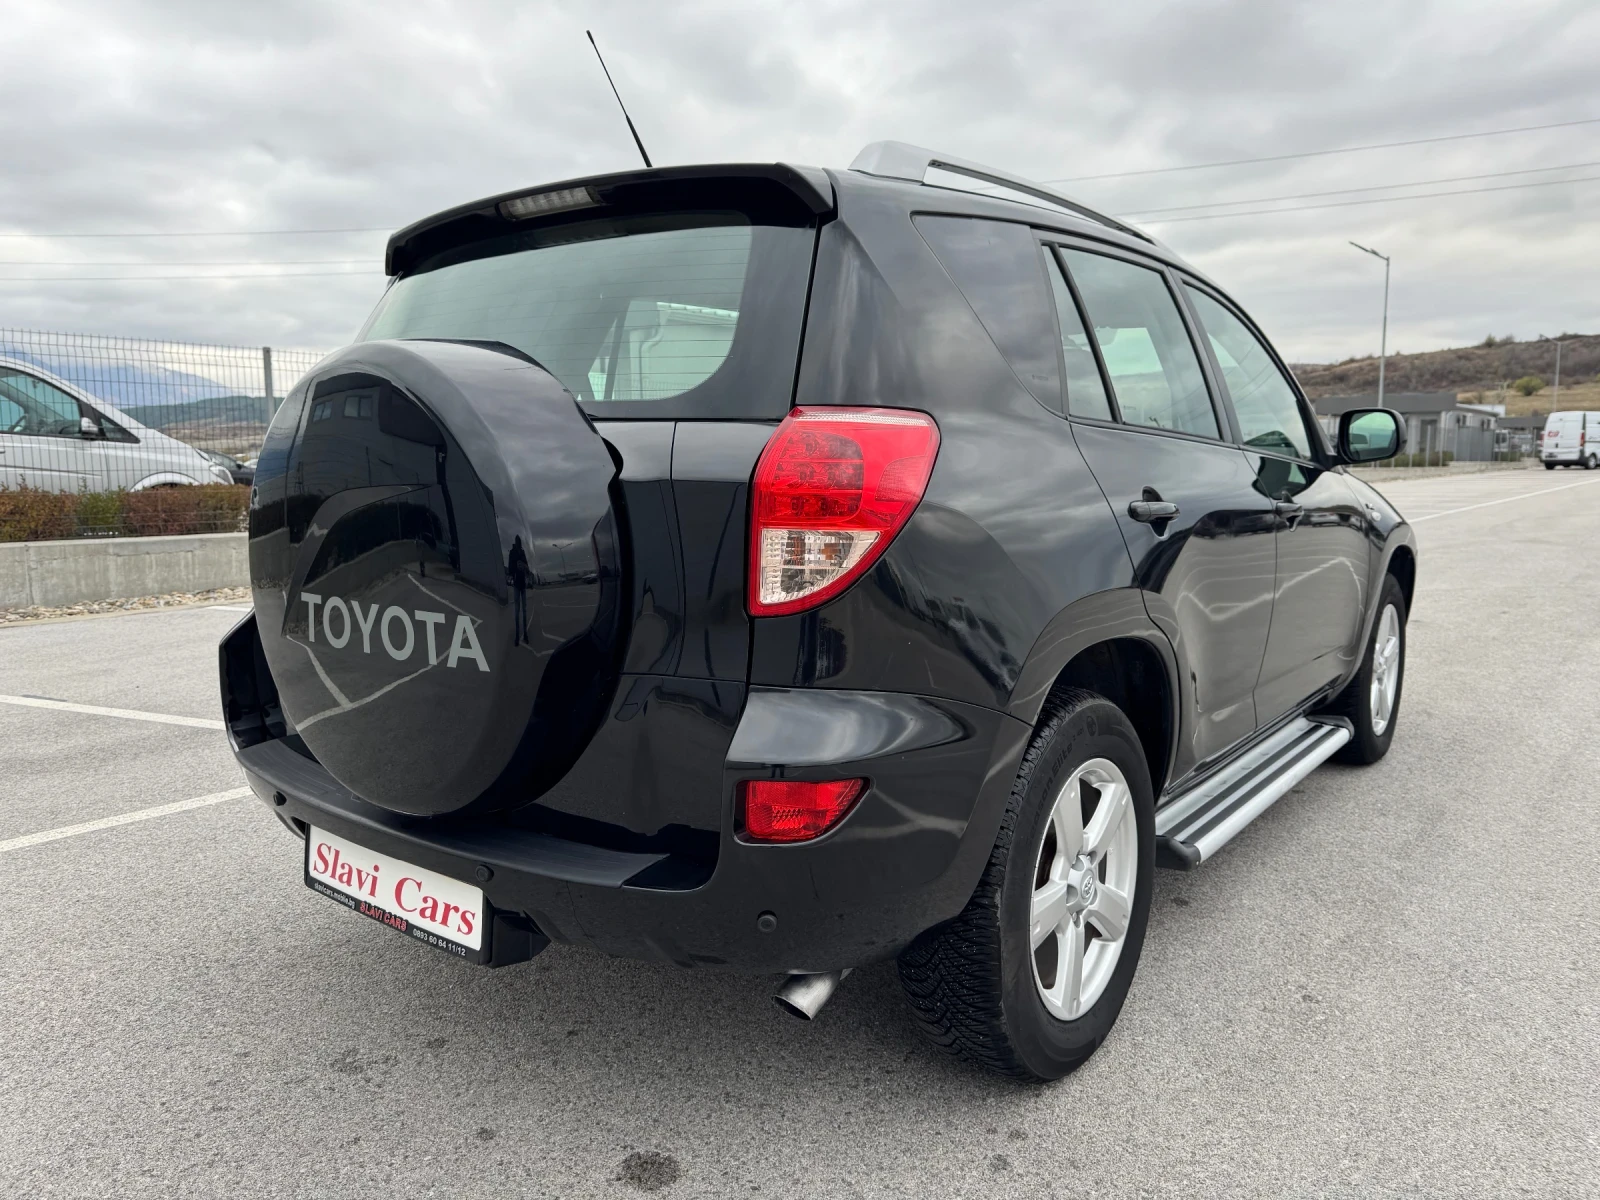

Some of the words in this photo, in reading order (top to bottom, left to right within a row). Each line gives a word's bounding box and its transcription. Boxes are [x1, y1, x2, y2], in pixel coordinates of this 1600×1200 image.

[301, 591, 491, 672] TOYOTA
[313, 842, 381, 898] Slavi
[394, 877, 476, 936] Cars
[360, 901, 383, 920] SLAVI
[384, 912, 407, 932] CARS
[412, 928, 429, 941] 0893
